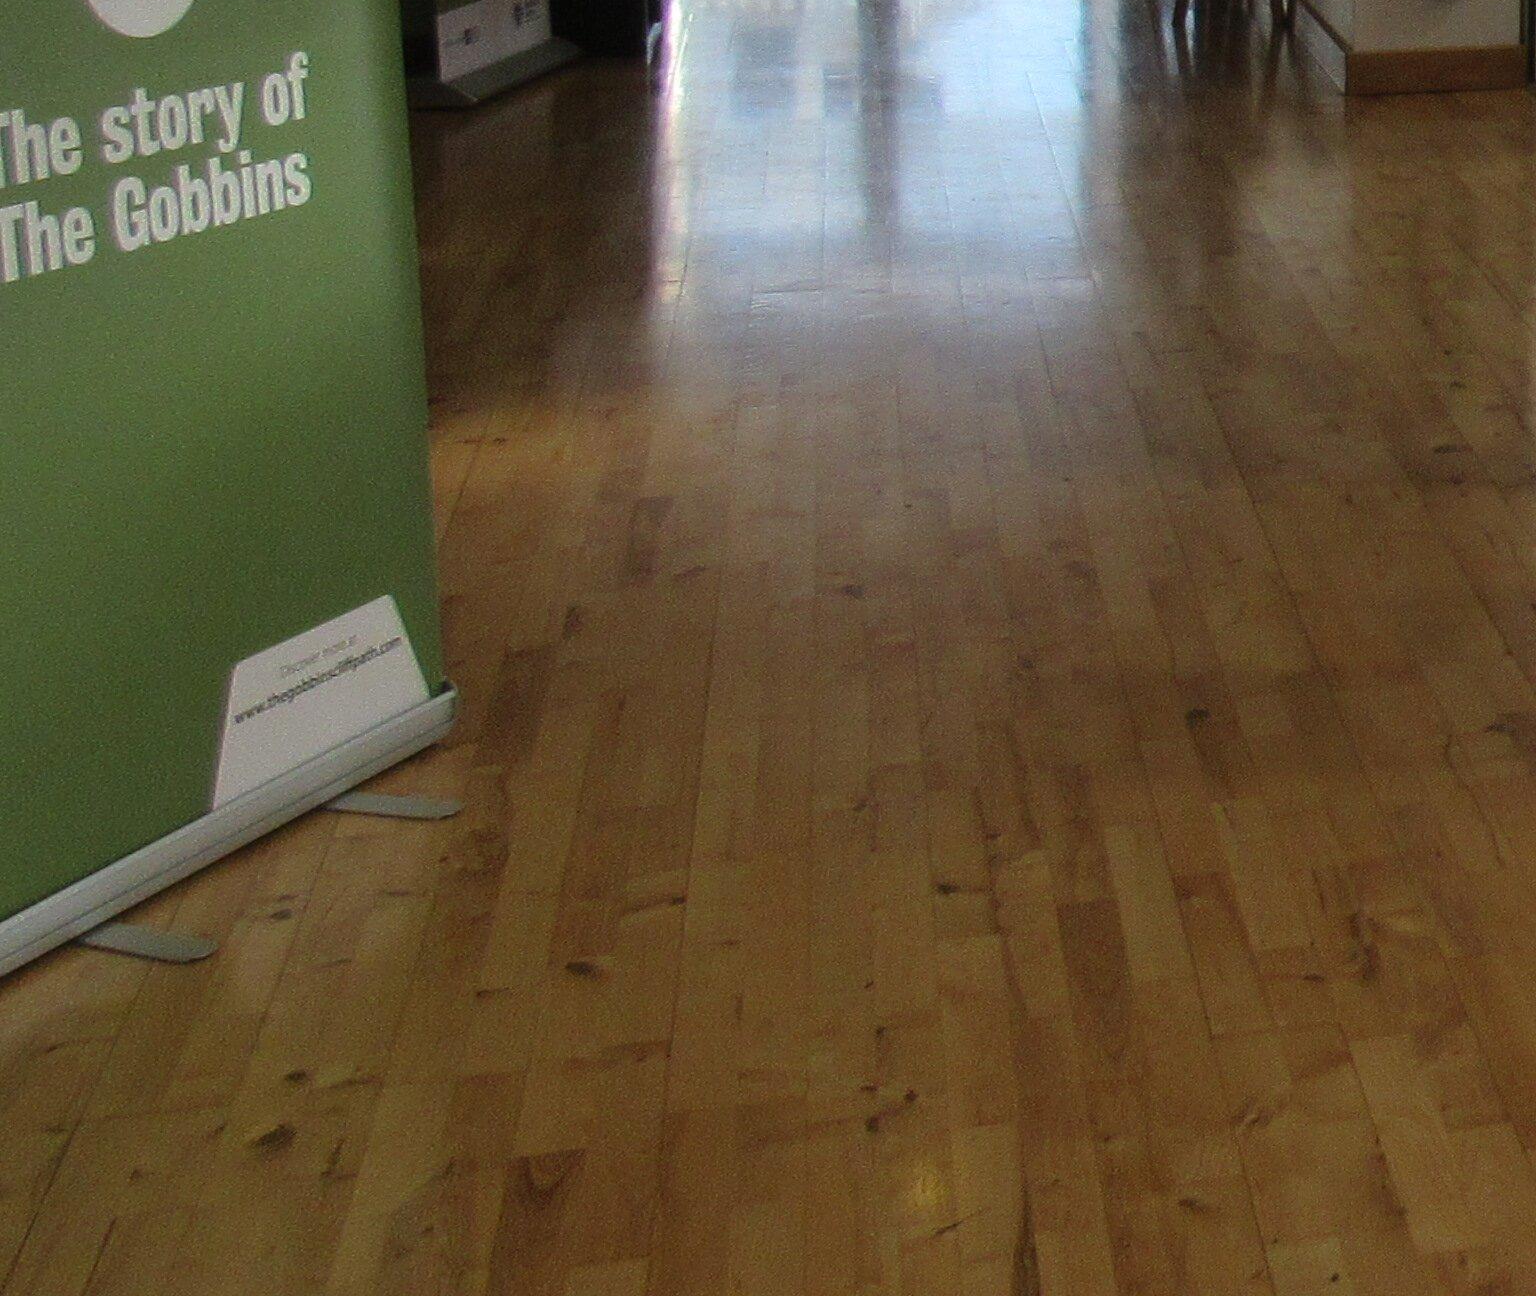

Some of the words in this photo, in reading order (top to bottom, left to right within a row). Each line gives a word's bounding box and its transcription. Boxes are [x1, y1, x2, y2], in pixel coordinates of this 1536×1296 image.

[100, 82, 245, 164] story
[261, 51, 310, 126] of
[0, 200, 96, 283] The
[112, 150, 312, 252] Gobbins
